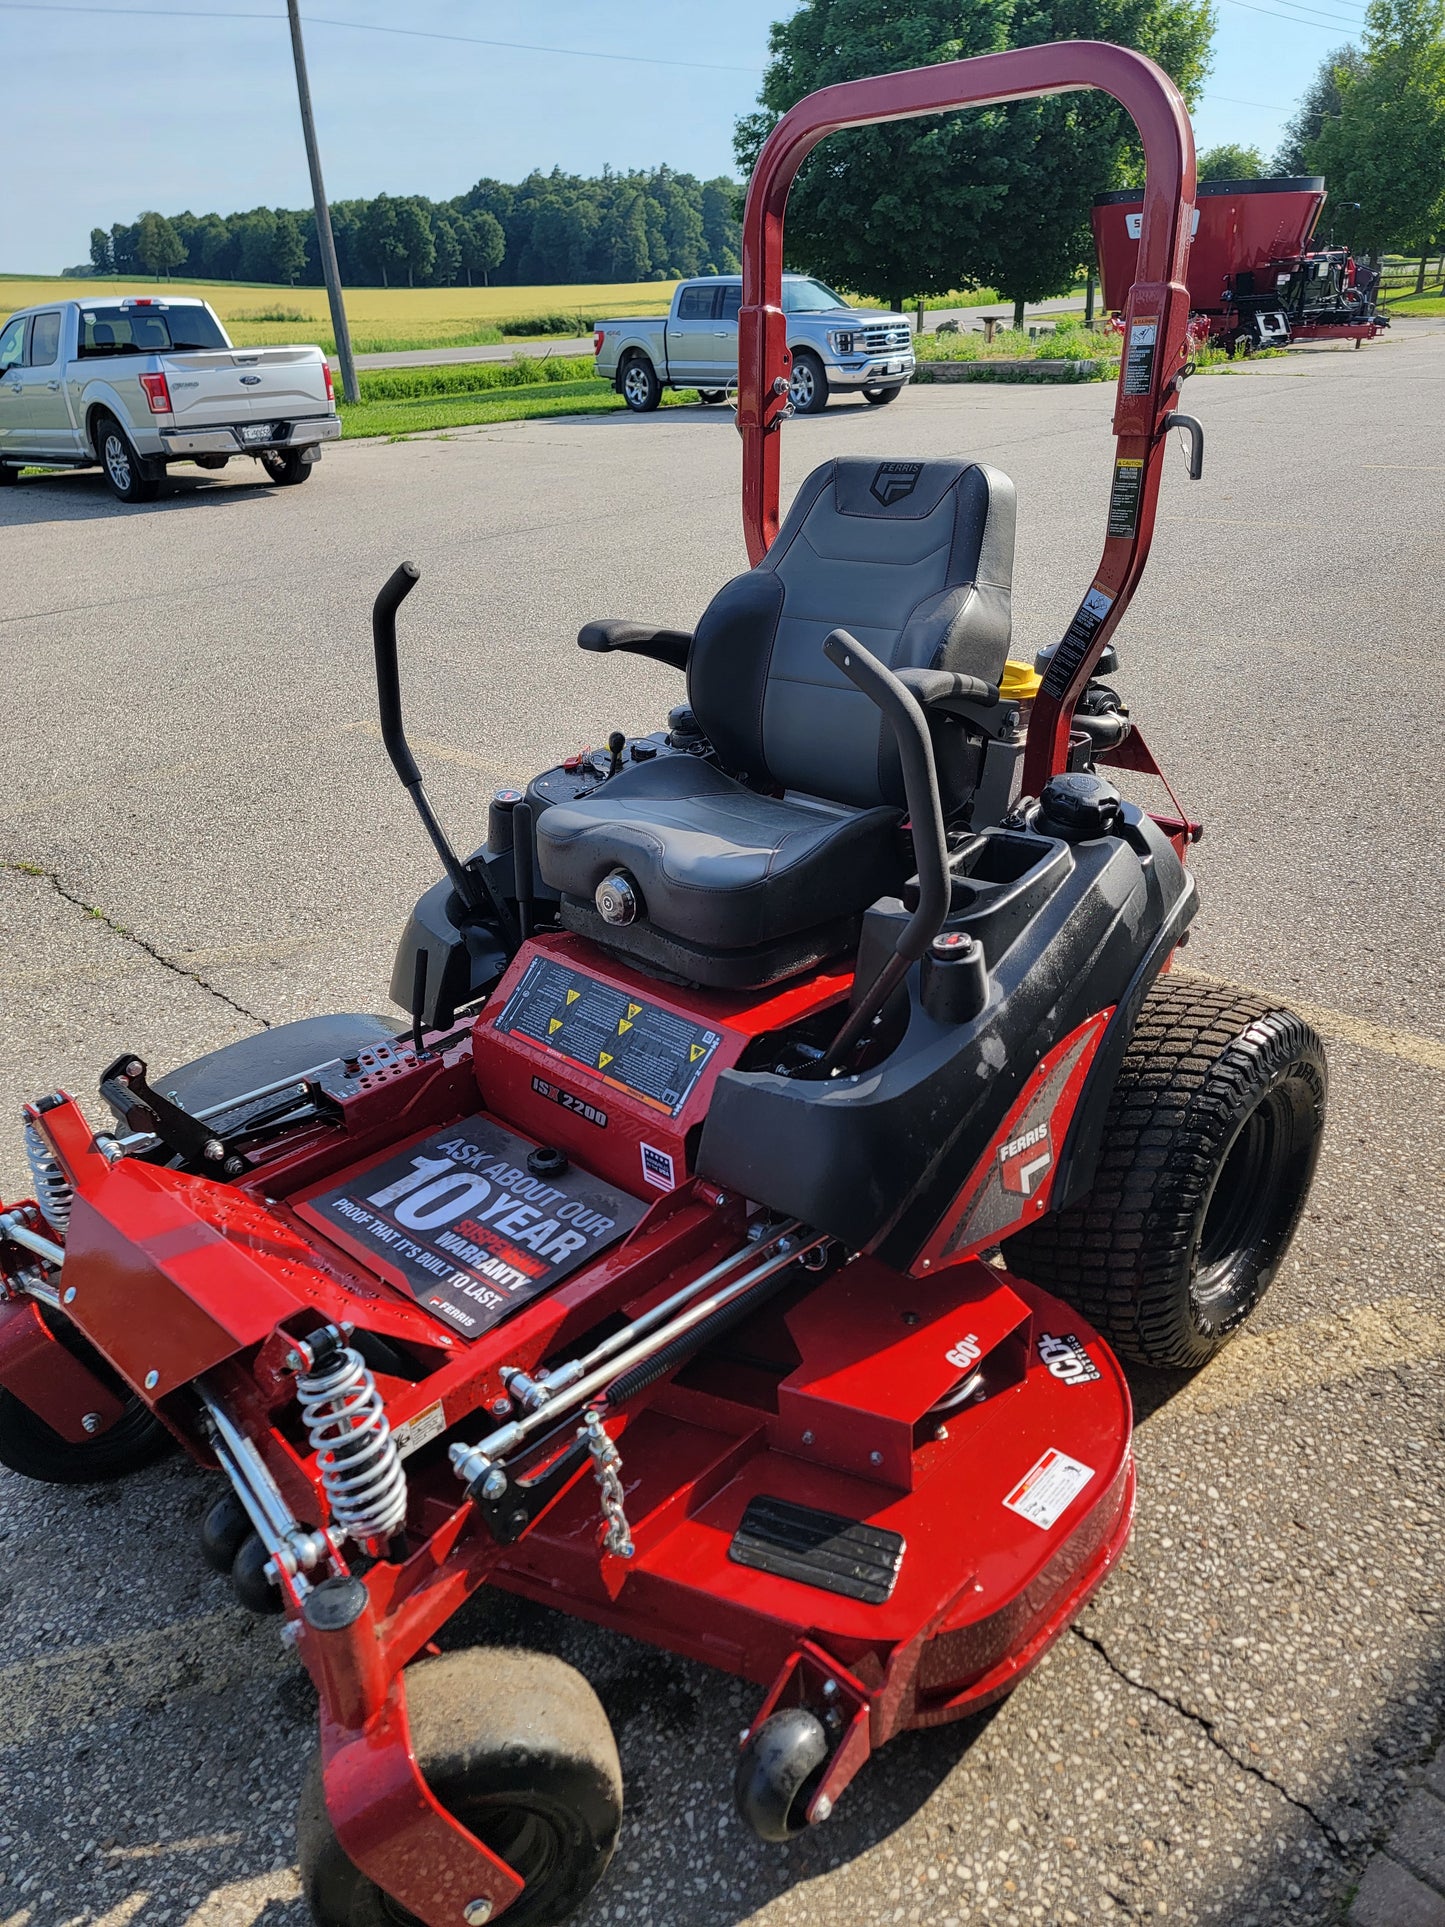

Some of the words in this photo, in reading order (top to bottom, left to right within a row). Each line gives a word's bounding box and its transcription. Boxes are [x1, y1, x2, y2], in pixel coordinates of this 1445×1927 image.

[881, 463, 920, 473] FERRIS
[532, 1077, 560, 1101] ISX
[562, 1093, 607, 1127] 2200
[1000, 1122, 1048, 1162] FERRIS
[366, 1155, 491, 1231] 10
[476, 1192, 587, 1264] YEAR
[436, 1138, 495, 1170] ASK
[480, 1161, 568, 1208] ABOUT
[556, 1201, 616, 1238] OUR
[331, 1198, 374, 1225] PROOF
[366, 1219, 402, 1243] THAT
[392, 1238, 422, 1259] IT'S
[414, 1252, 455, 1277] BUILT
[446, 1270, 471, 1289] TO
[462, 1282, 503, 1310] LAST.
[434, 1230, 532, 1291] WARRANTY
[453, 1219, 552, 1280] SUSPENSION
[438, 1301, 477, 1327] FERRIS
[945, 1333, 982, 1369] 60"
[1066, 1335, 1101, 1380] CUTTING
